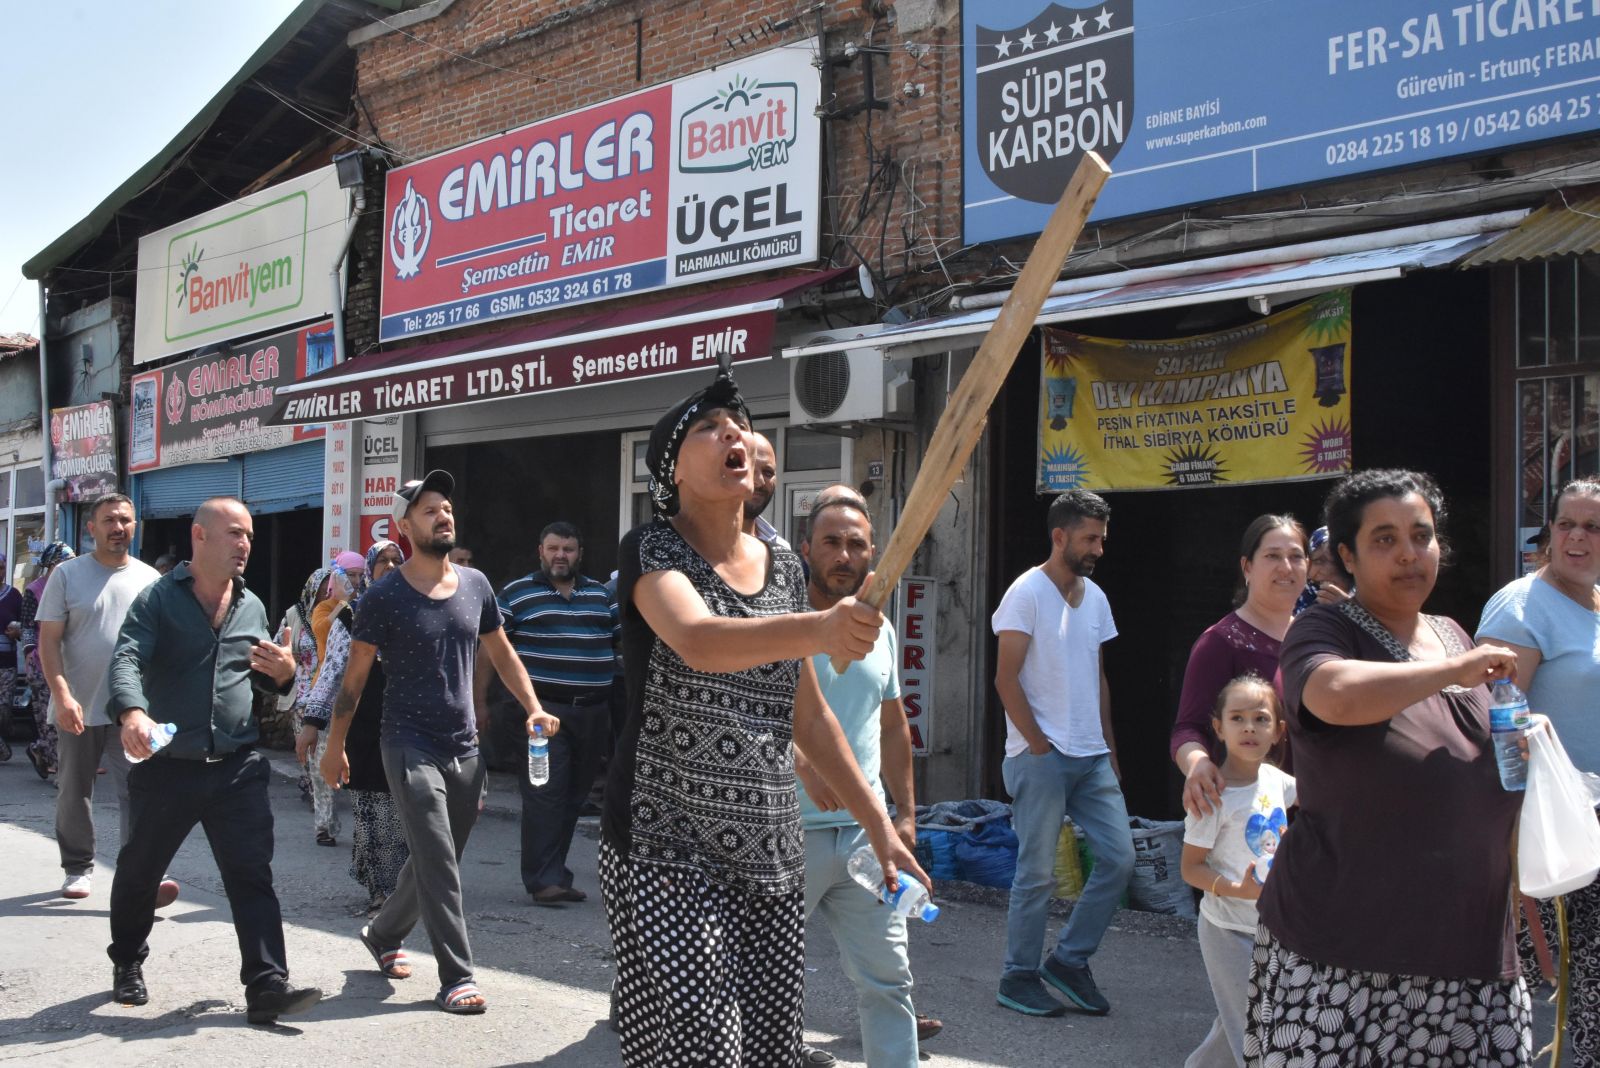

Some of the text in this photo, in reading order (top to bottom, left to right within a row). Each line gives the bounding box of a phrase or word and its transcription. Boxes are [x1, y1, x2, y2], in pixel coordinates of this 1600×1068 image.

[1328, 13, 1444, 76] FER-SA
[1001, 58, 1108, 123] SÜPER
[1396, 68, 1465, 99] Gürevin
[1480, 55, 1541, 83] Ertunç
[686, 98, 787, 160] Banvit
[989, 101, 1124, 172] KARBON
[1145, 98, 1220, 129] EDİRNE BAYİSİ
[1145, 115, 1267, 150] www.superkarbon.com
[1326, 141, 1369, 165] 0284
[1372, 132, 1404, 157] 225
[1410, 127, 1431, 149] 18
[1436, 123, 1457, 144] 19
[1474, 109, 1521, 136] 0542
[1525, 101, 1561, 128] 684
[1567, 95, 1591, 120] 25
[438, 112, 654, 221] EMİRLER
[748, 139, 790, 172] YEM
[549, 189, 652, 239] Ticaret
[675, 183, 802, 245] ÜÇEL
[461, 236, 614, 293] Şemsettin EMİR
[679, 233, 799, 273] HARMANLI KÖMÜRÜ
[403, 273, 632, 332] Tel: 225 17 66 GSM: 0532 324 61 78
[187, 345, 280, 398] EMİRLER
[283, 325, 748, 421] EMİRLER TİCARET LTD.ŞTİ. Şemsettin EMİR
[1091, 360, 1288, 411] DEV KAMPANYA
[190, 384, 275, 423] KÖMÜRCÜLÜK
[1097, 398, 1297, 433] PEŞİN FİYATINA TAKSİTLE
[364, 435, 399, 456] ÜÇEL
[1103, 417, 1290, 450] İTHAL SİBİRYA KÖMÜRÜ
[1317, 448, 1347, 462] 6 TAKSİT
[56, 449, 113, 478] KÖMÜRCÜLÜK
[364, 476, 397, 494] HAR
[1055, 473, 1076, 483] TAKSİT
[1185, 471, 1211, 483] TAKSİT
[903, 582, 926, 749] FER-SA
